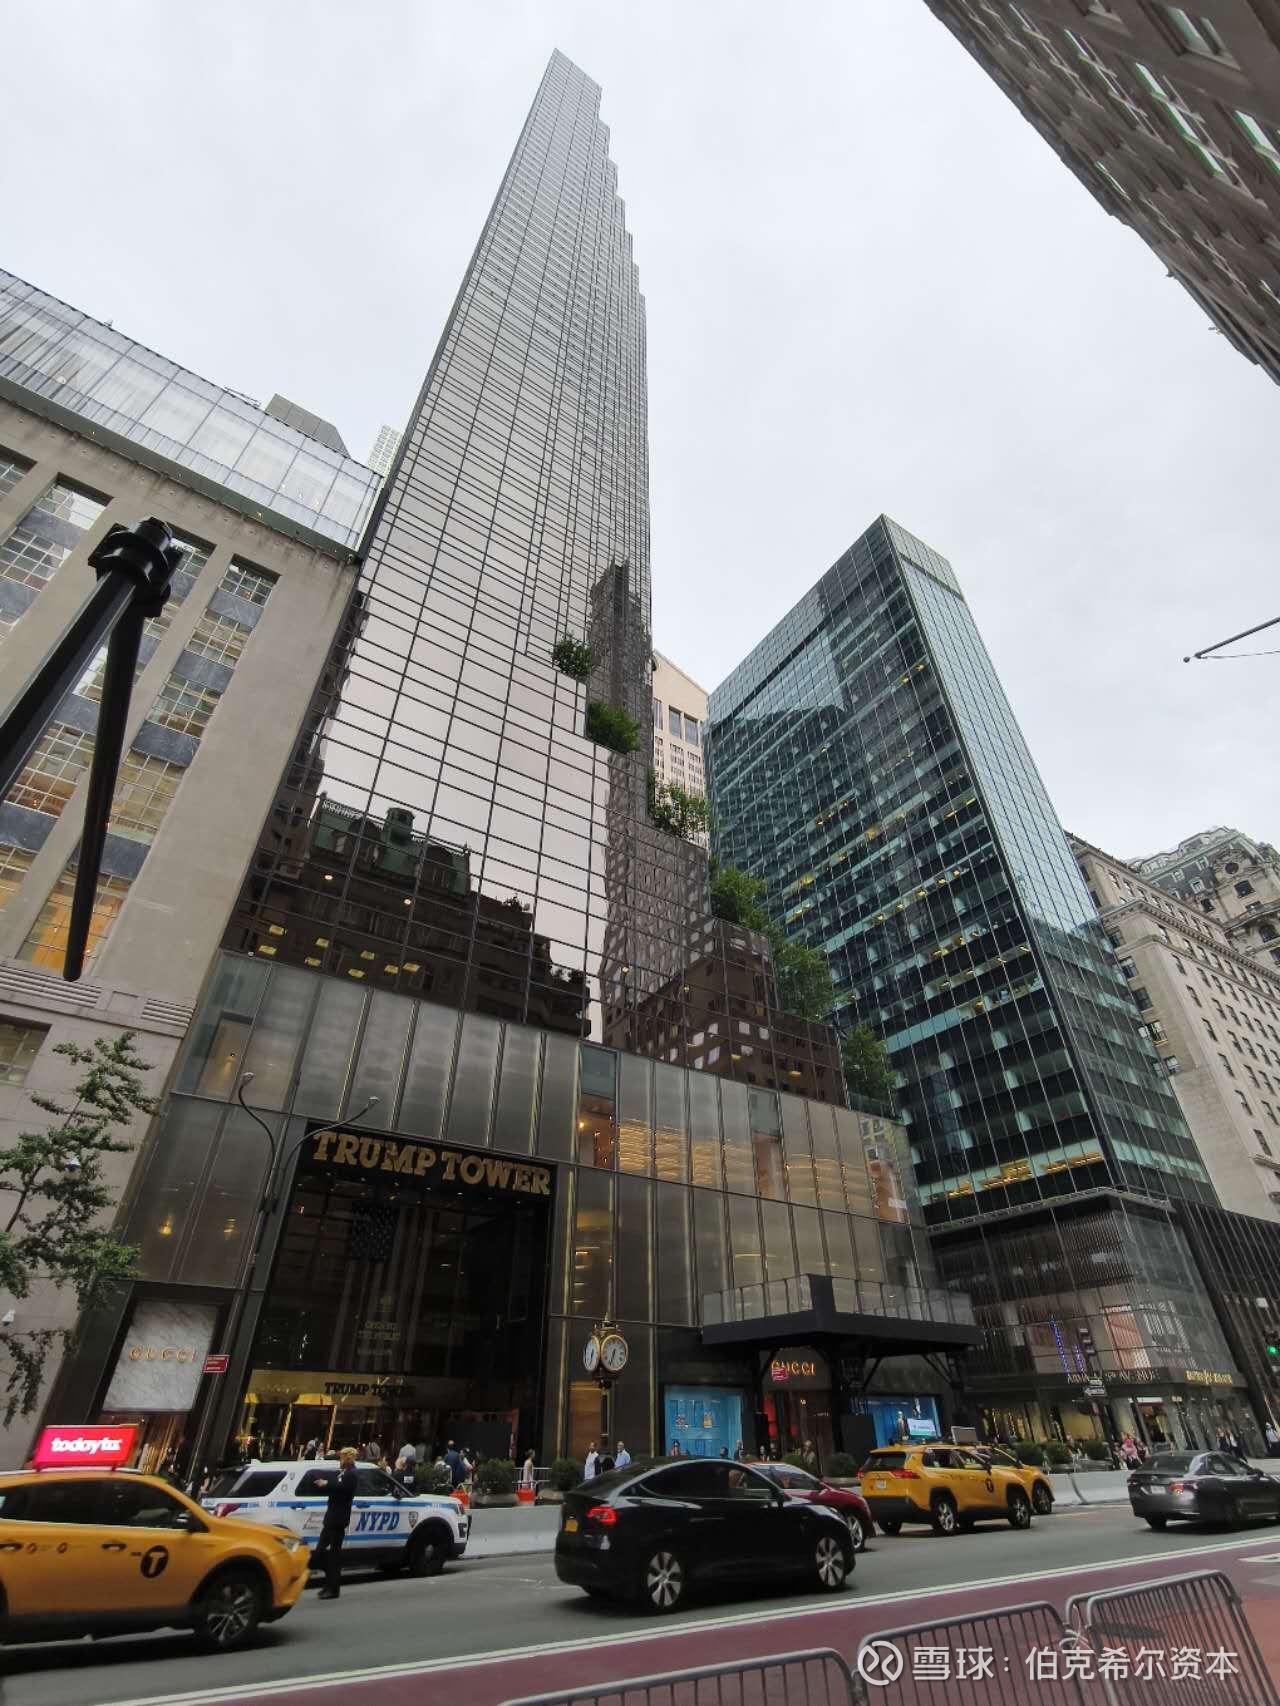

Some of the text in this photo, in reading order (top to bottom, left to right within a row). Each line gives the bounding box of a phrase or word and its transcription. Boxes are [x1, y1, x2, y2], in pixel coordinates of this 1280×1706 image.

[313, 1131, 550, 1195] TRUMP TOWER
[128, 1346, 196, 1363] GUCCI
[771, 1360, 816, 1376] GUCCI
[325, 1382, 369, 1395] TRUMP
[355, 1511, 400, 1532] NYPD
